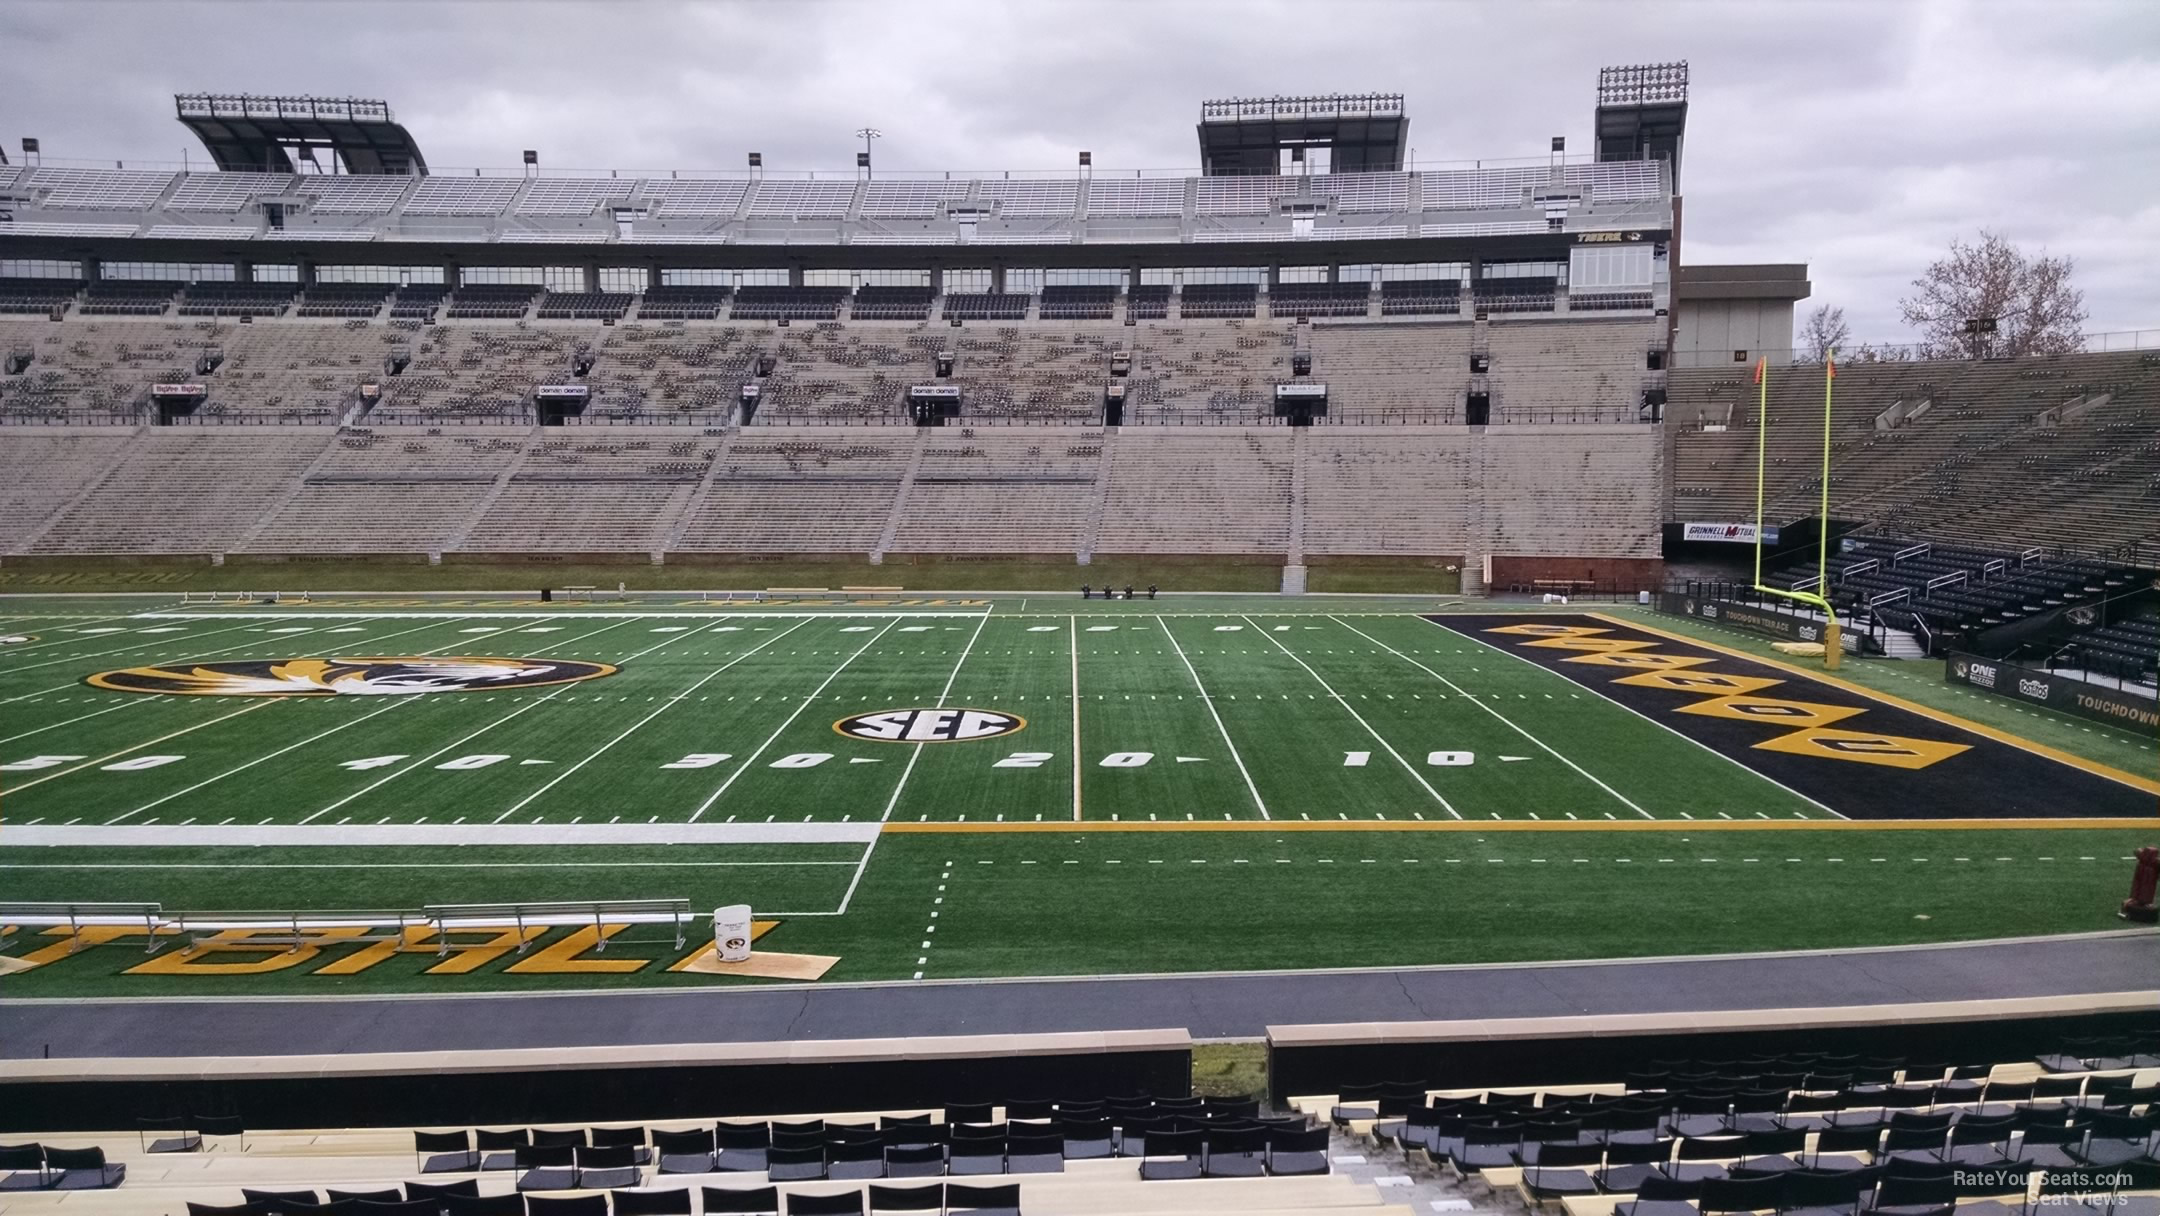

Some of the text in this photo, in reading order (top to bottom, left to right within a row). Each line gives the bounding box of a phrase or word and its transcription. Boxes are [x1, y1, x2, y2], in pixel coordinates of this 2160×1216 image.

[1688, 526, 1725, 535] GRINNELL
[1725, 526, 1756, 537] MUTUAL
[1726, 611, 1761, 625] TOUCHDOWN
[1970, 663, 1997, 678] ONE
[1969, 674, 1995, 687] MIZZOU
[2077, 694, 2160, 727] TOUCHDOWN
[851, 710, 1009, 740] SEC
